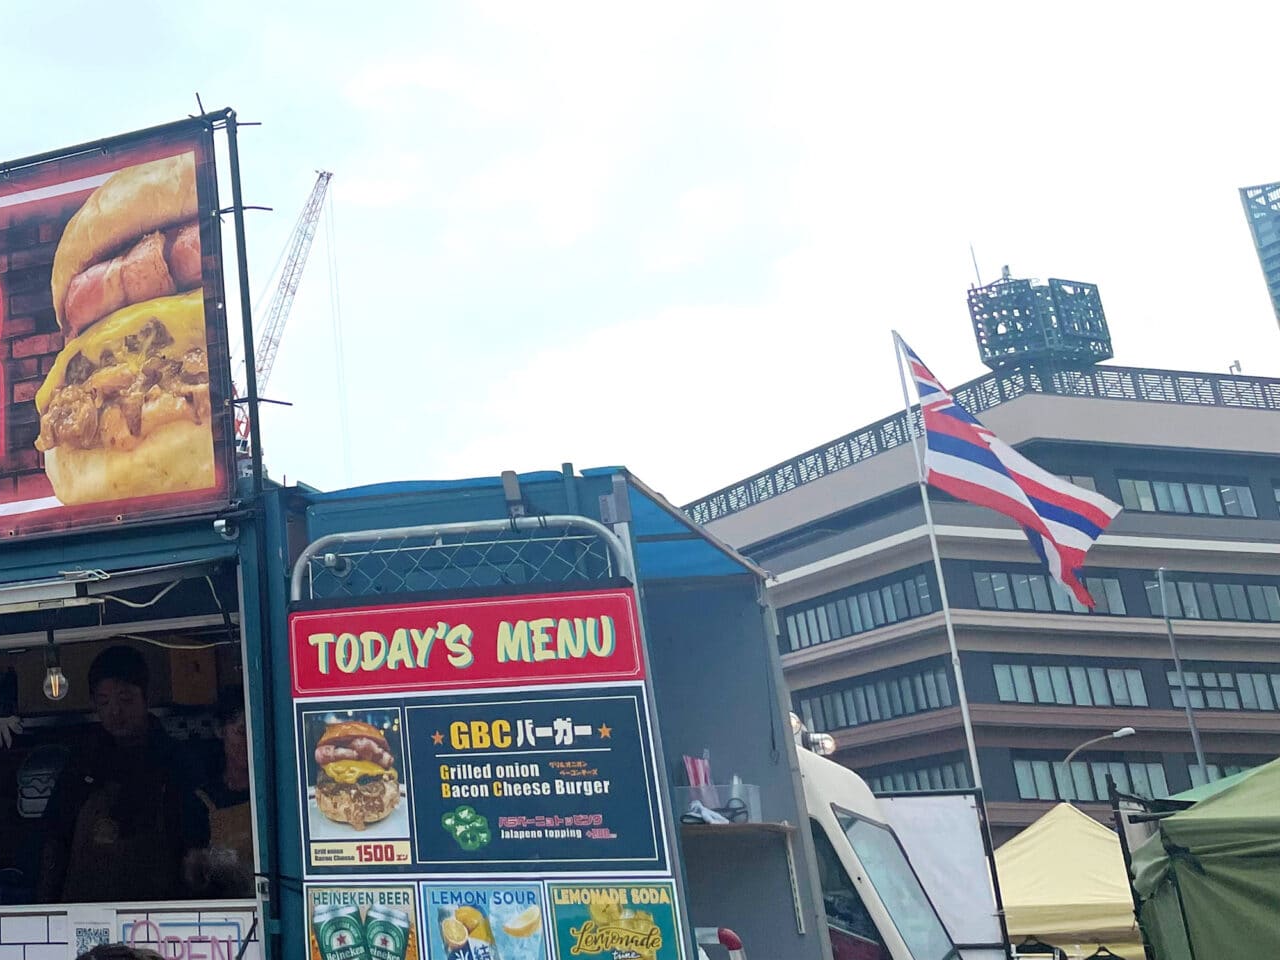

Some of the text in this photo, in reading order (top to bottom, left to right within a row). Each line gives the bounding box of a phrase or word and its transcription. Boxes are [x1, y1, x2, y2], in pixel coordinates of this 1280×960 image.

[308, 615, 616, 673] TODAY'S MENU
[449, 717, 593, 750] GBC バーガー
[439, 762, 540, 780] Grilled onion
[441, 779, 610, 799] Bacon Cheese Burger
[356, 844, 395, 862] 1500
[313, 891, 410, 905] HEINEKEN BEER
[431, 890, 537, 905] LEMON SOUR
[553, 887, 671, 905] LEMONADE SODA
[131, 920, 233, 960] OPEN
[569, 921, 662, 954] Lemonade
